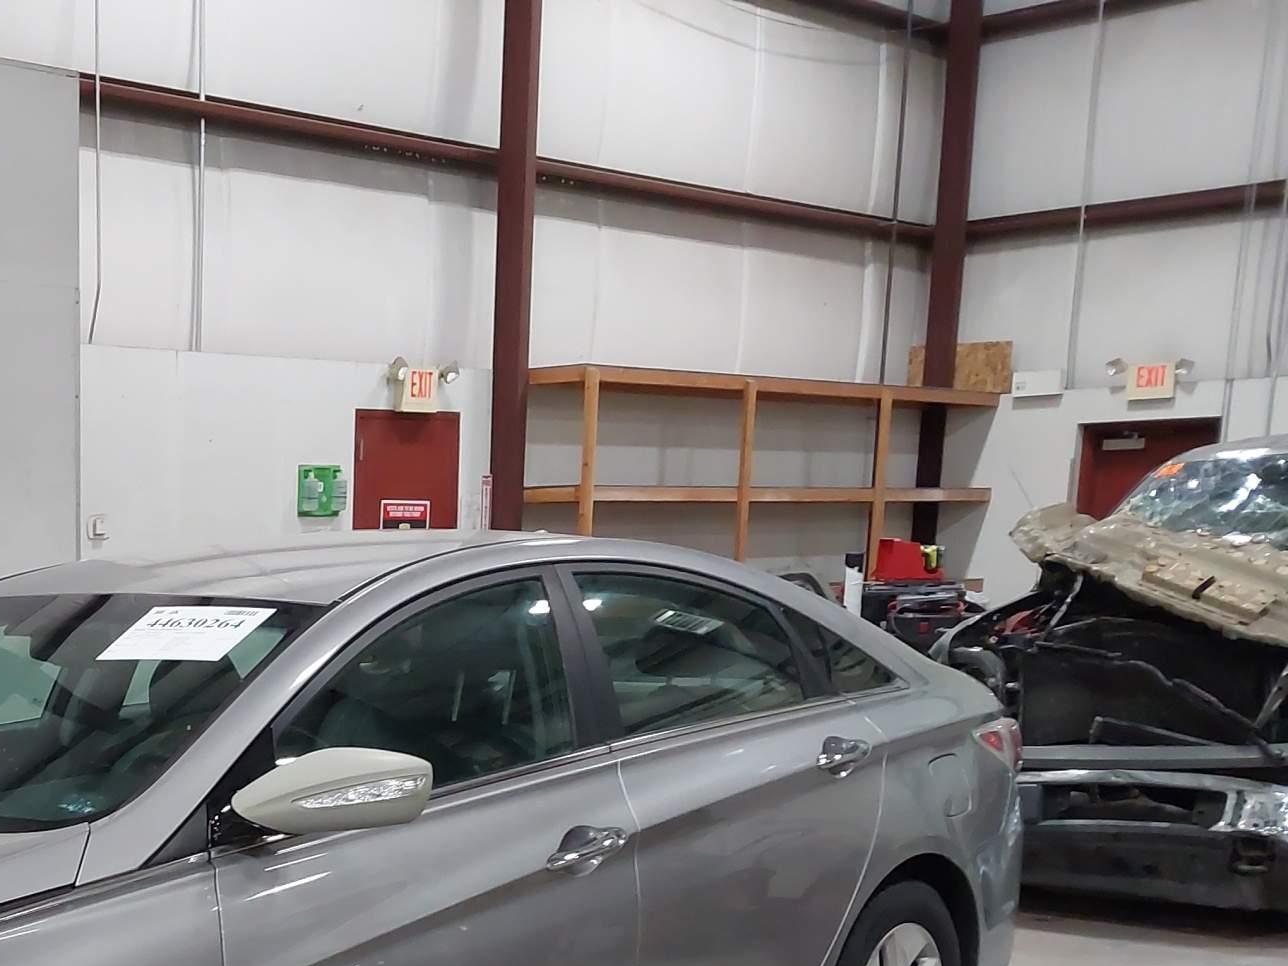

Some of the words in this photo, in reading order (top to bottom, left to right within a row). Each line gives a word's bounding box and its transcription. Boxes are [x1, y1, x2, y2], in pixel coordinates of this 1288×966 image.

[410, 370, 433, 399] EXIT
[1136, 365, 1168, 388] EXIT
[146, 617, 246, 630] 44630264
